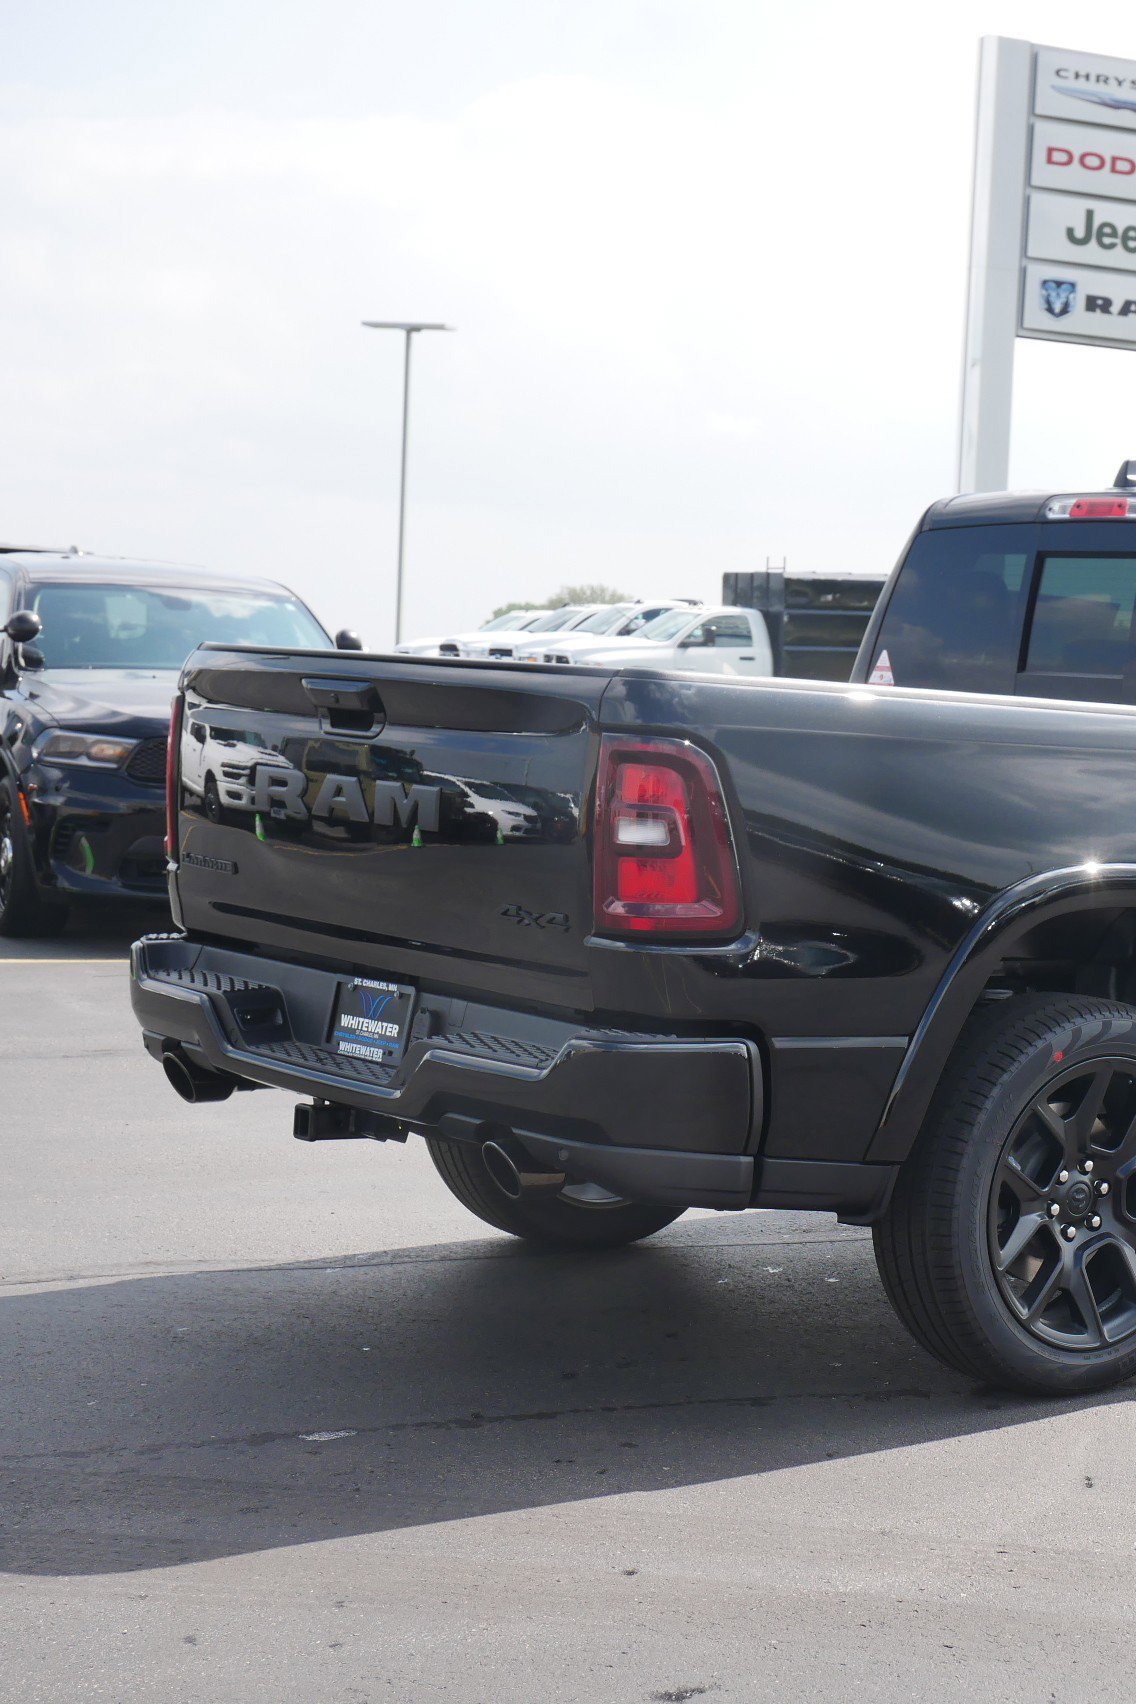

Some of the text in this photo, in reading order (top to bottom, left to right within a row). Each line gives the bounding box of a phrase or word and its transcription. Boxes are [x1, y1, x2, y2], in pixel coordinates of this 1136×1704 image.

[255, 765, 442, 832] RAM
[341, 1014, 399, 1037] WHITEWATER
[340, 1041, 383, 1058] WHITEWATER
